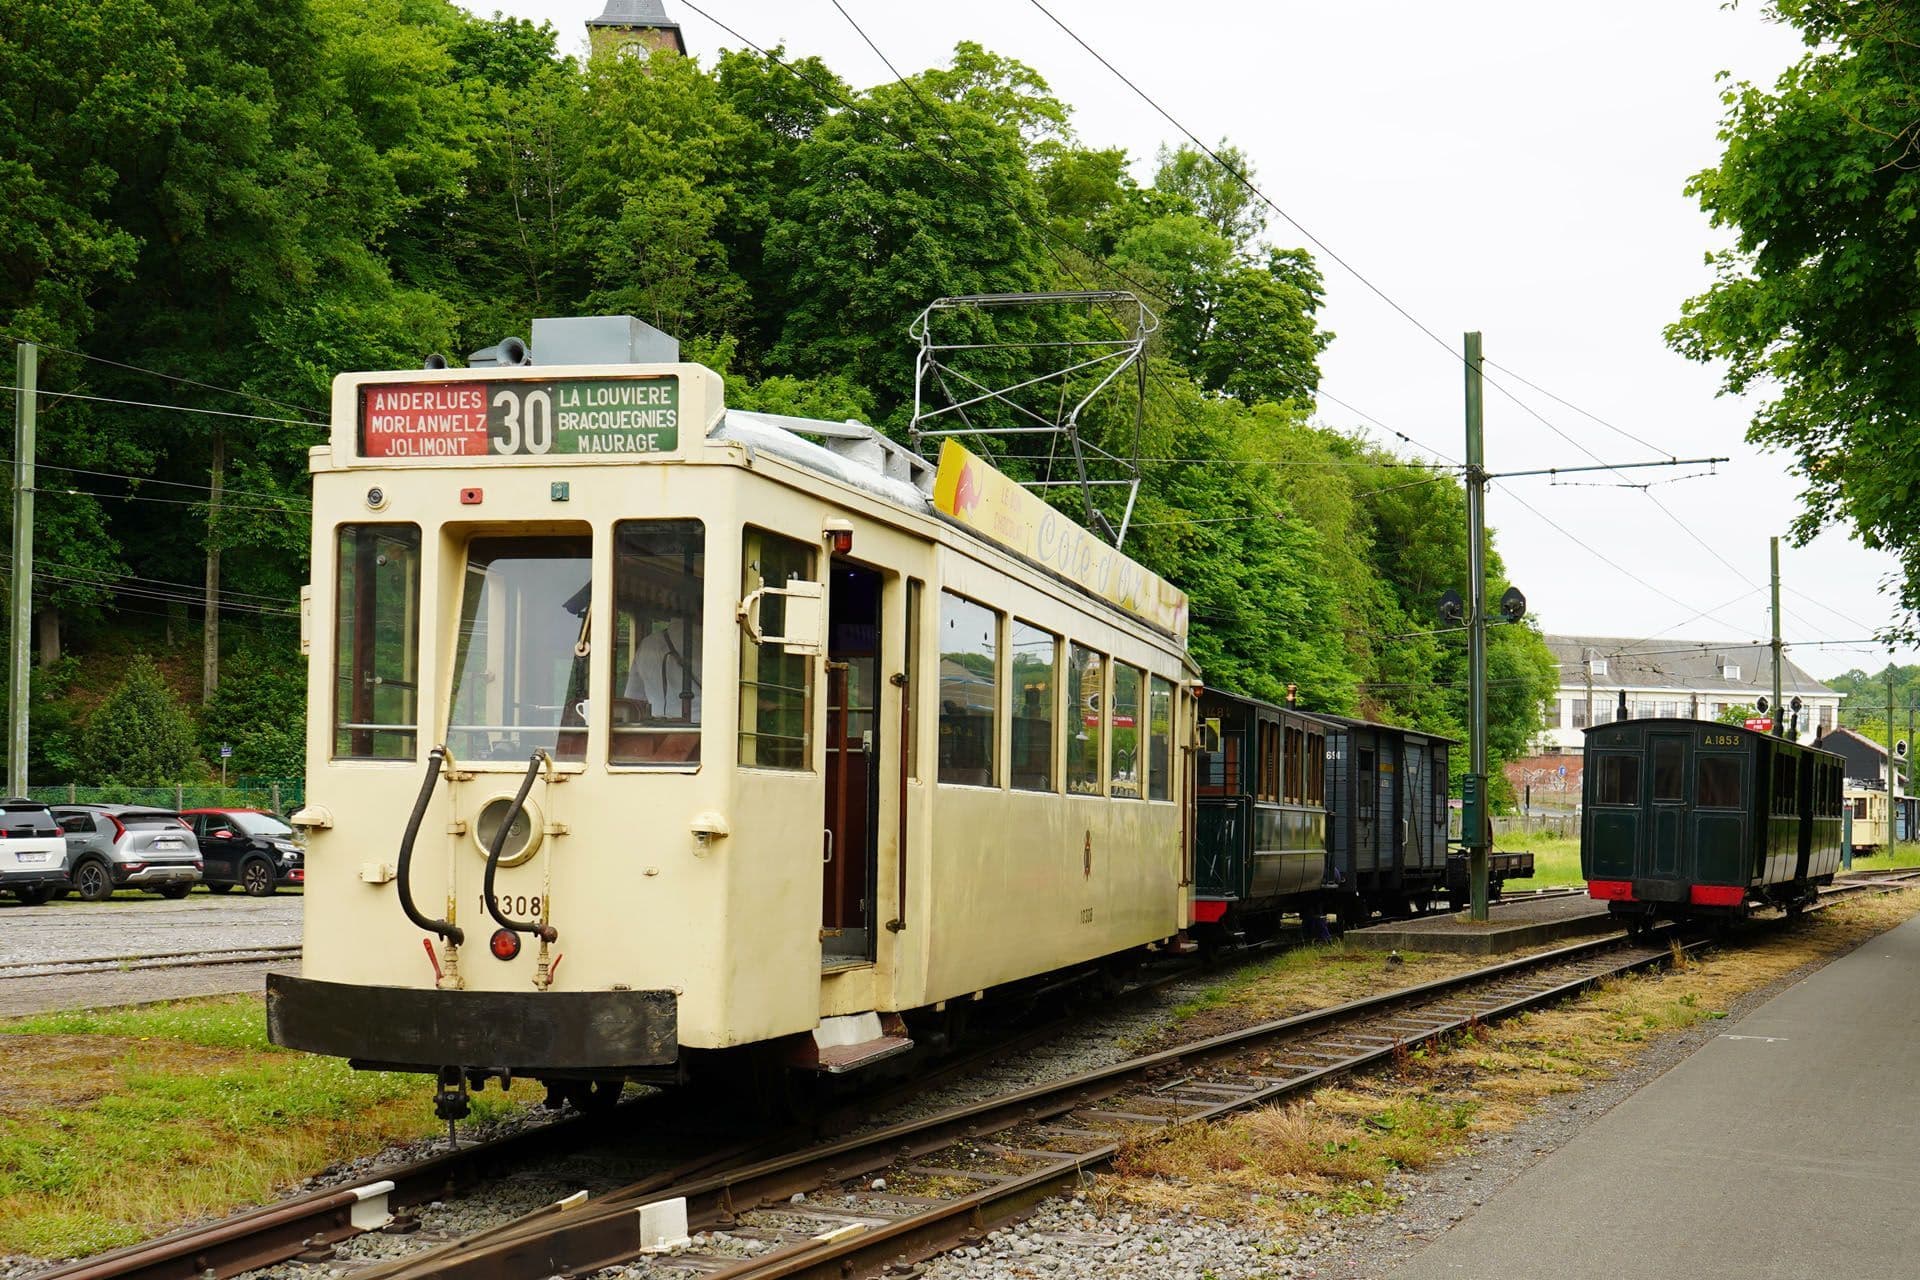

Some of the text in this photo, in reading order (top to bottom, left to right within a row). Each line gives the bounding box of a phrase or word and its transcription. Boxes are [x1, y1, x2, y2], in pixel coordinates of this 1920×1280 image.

[375, 391, 482, 411] ANDERLUES
[560, 386, 672, 407] LA LOUVIERE
[372, 414, 487, 433] MORLANWELZ
[492, 390, 552, 455] 30
[558, 410, 677, 431] BRACQUEGNIES
[385, 437, 469, 456] JOLIMONT
[578, 433, 660, 453] MAURAGE
[1704, 735, 1740, 746] A.1853
